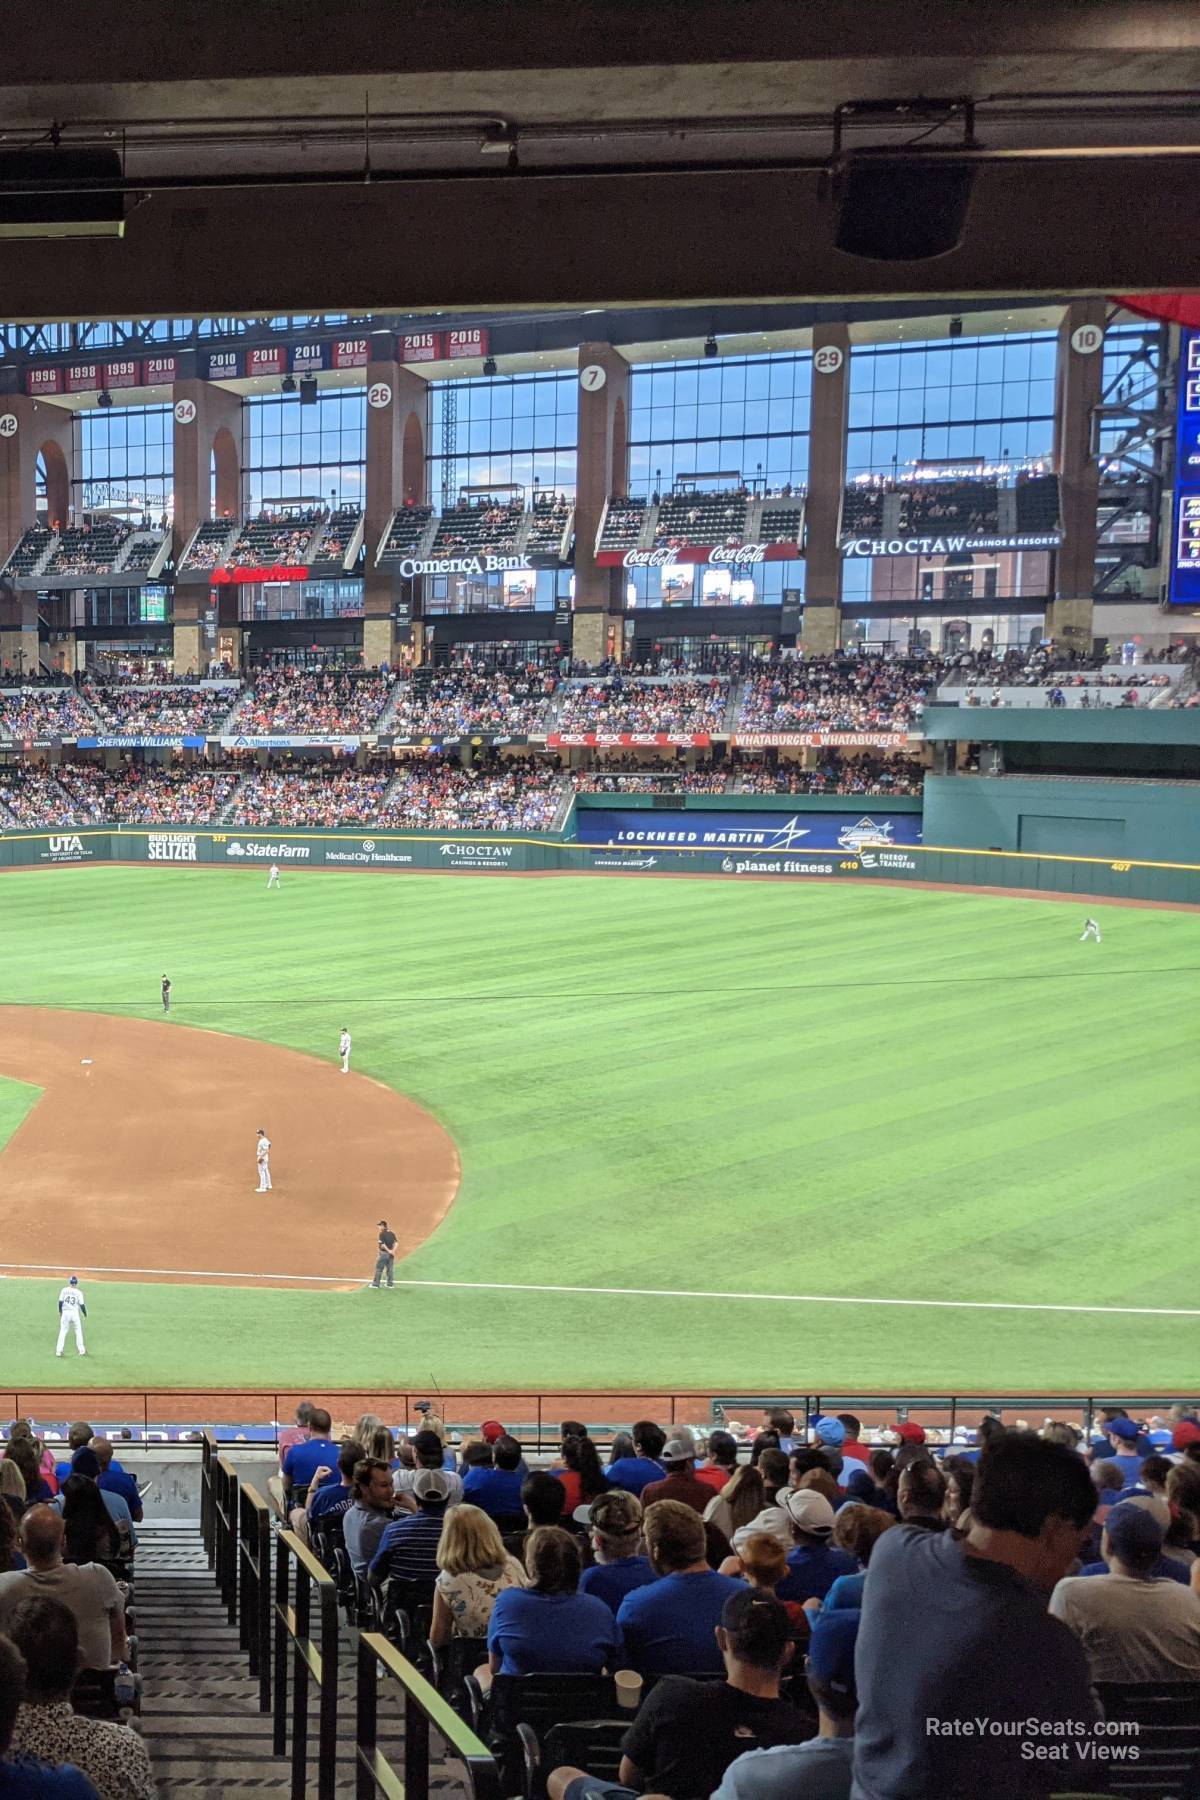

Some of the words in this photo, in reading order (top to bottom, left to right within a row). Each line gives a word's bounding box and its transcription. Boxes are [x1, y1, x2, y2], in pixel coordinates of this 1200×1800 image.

[404, 334, 433, 348] 2015
[450, 330, 480, 344] 2016
[1077, 331, 1096, 345] 10
[295, 345, 321, 359] 2011
[338, 340, 366, 354] 2012
[210, 353, 236, 366] 2010
[253, 349, 278, 362] 2011
[817, 353, 839, 367] 29
[108, 362, 135, 376] 1999
[148, 358, 175, 372] 2010
[31, 370, 56, 382] 1996
[70, 366, 96, 379] 1998
[588, 371, 598, 386] 7
[371, 389, 389, 403] 26
[177, 404, 193, 419] 34
[0, 419, 15, 432] 42
[855, 537, 965, 556] CHOCTAW
[966, 540, 1007, 548] CASINOS
[1017, 536, 1060, 545] RESORTS
[485, 553, 532, 571] Bank
[97, 737, 184, 747] SHERWIN-WILLIAMS
[250, 738, 291, 747] Albertsons
[560, 734, 585, 742] DEX
[595, 734, 620, 742] DEX
[667, 734, 692, 742] DEX
[735, 734, 813, 746] WHATABURGER
[820, 734, 900, 745] WHATABURGER
[169, 835, 196, 843] LIGHT
[618, 831, 697, 842] LOCKHEED
[703, 832, 765, 843] MARTIN
[49, 836, 84, 852] UTA
[447, 844, 512, 856] CHOCTAW
[148, 842, 197, 861] SELTZER
[325, 852, 354, 861] Medical
[354, 852, 370, 863] City
[371, 853, 413, 862] Healthcare
[736, 861, 781, 873] planet
[784, 860, 833, 873] fitness
[840, 862, 858, 870] 410
[880, 861, 915, 869] TRANSFER
[65, 1296, 76, 1305] 43
